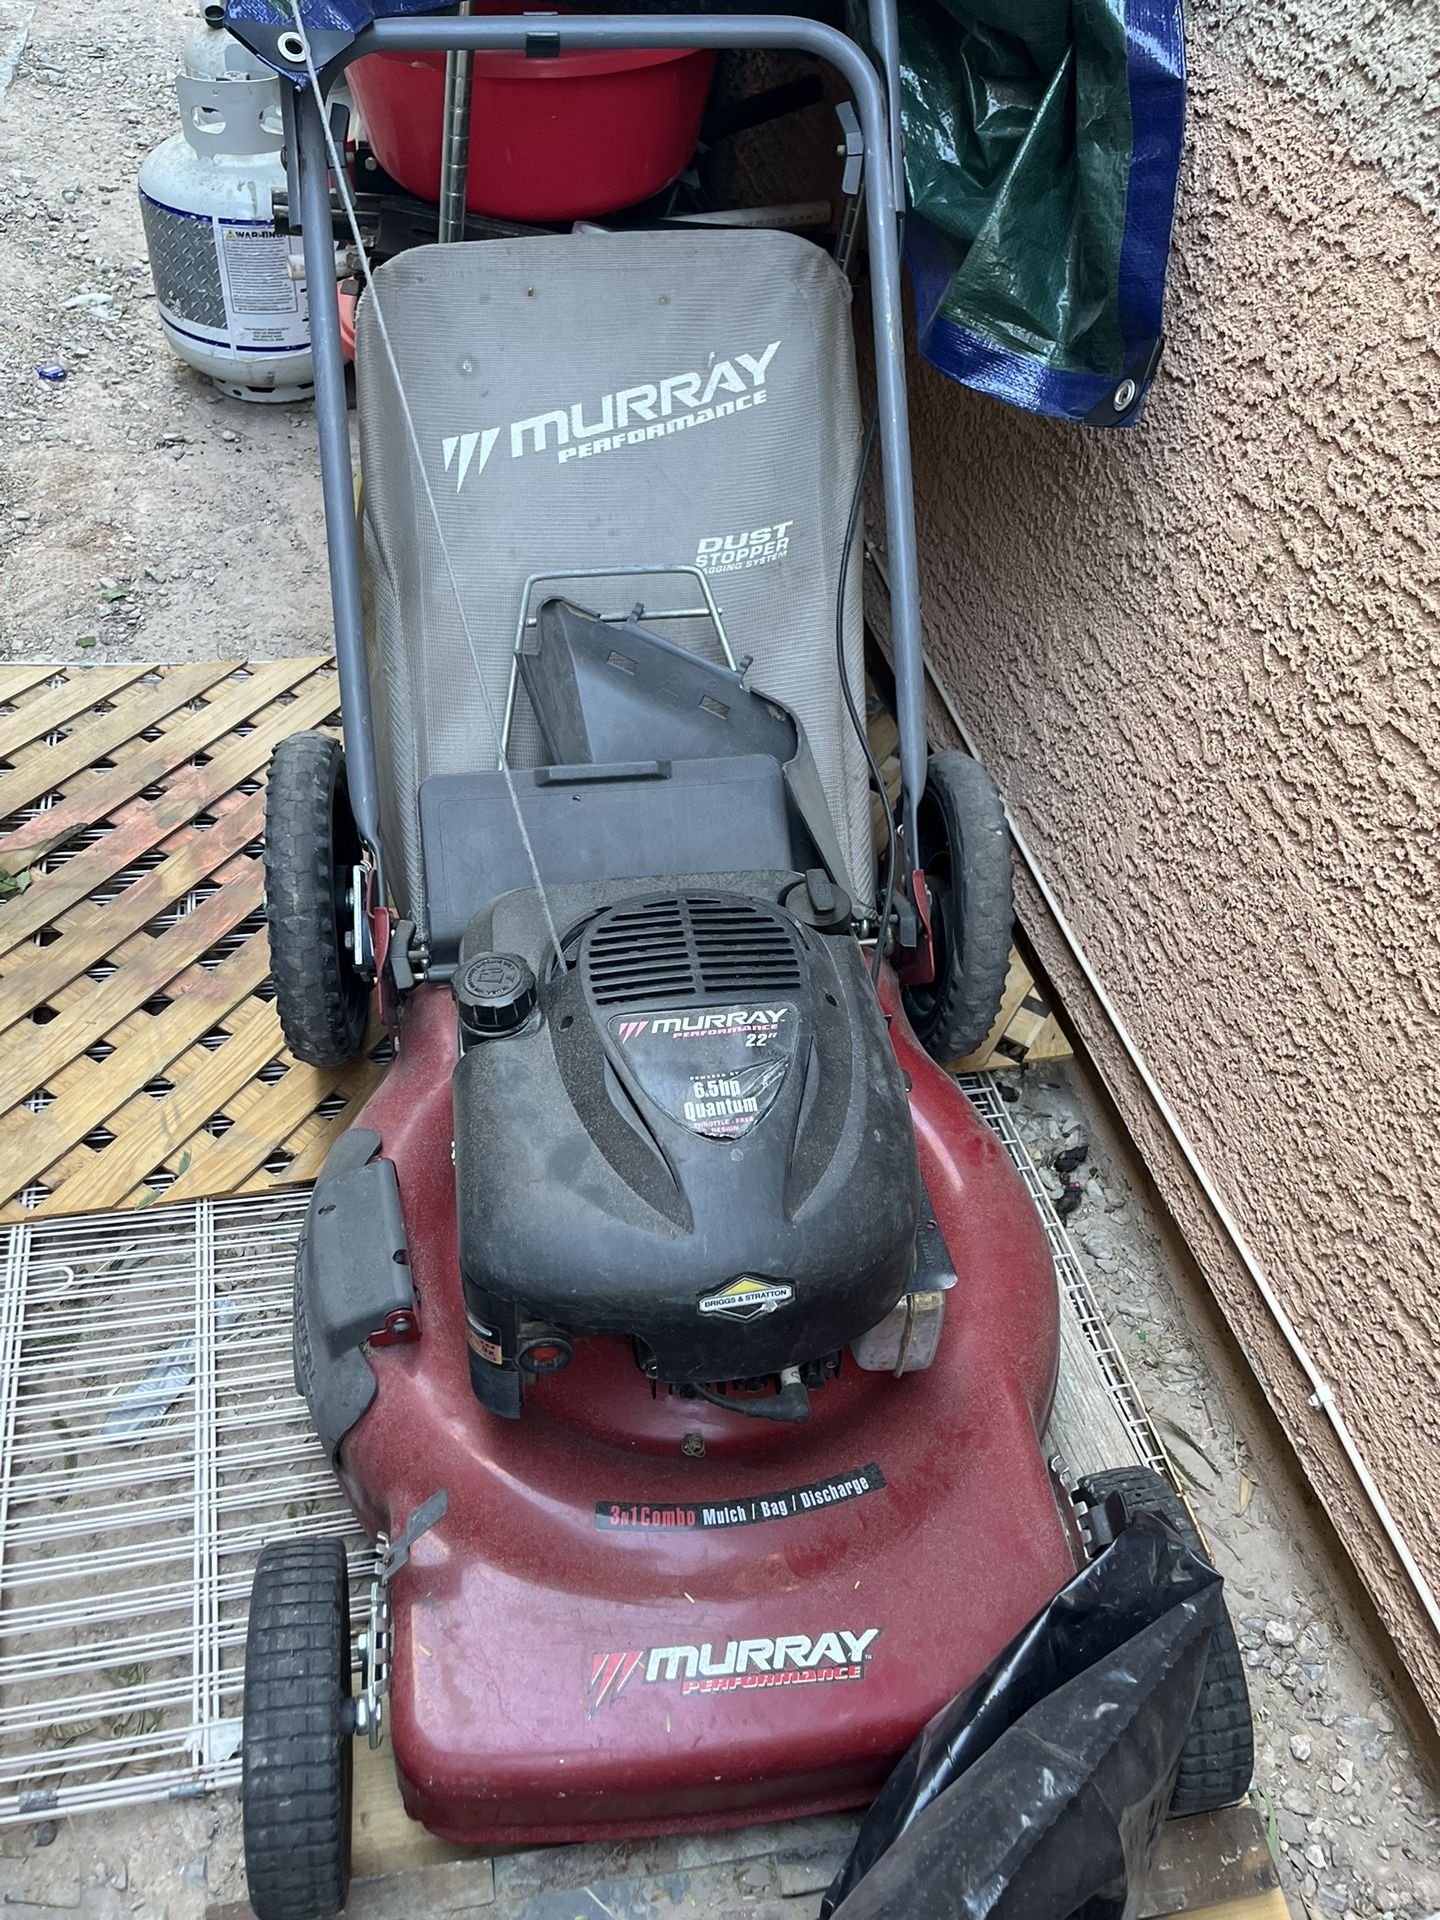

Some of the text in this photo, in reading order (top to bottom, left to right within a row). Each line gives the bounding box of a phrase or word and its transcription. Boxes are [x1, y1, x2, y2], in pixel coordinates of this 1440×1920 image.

[511, 341, 781, 458] MURRAY
[558, 389, 768, 464] PERFORMANCE
[697, 520, 793, 554] DUST
[695, 537, 790, 568] STOPPER
[701, 550, 788, 576] AGGING SYSTEM
[651, 1008, 788, 1034] MURRAY
[672, 1023, 778, 1039] PERFORMANCE
[689, 1073, 726, 1081] POWERED
[693, 1079, 741, 1099] 6.5hp
[684, 1096, 758, 1122] Quantum
[704, 1297, 736, 1308] BRIGGS
[744, 1289, 787, 1302] STRATTON
[702, 1504, 747, 1526] Mulch
[761, 1500, 788, 1519] Bag
[800, 1475, 870, 1508] Discharge
[645, 1628, 880, 1681] MURRAY
[682, 1665, 861, 1694] PERFORMANCE
